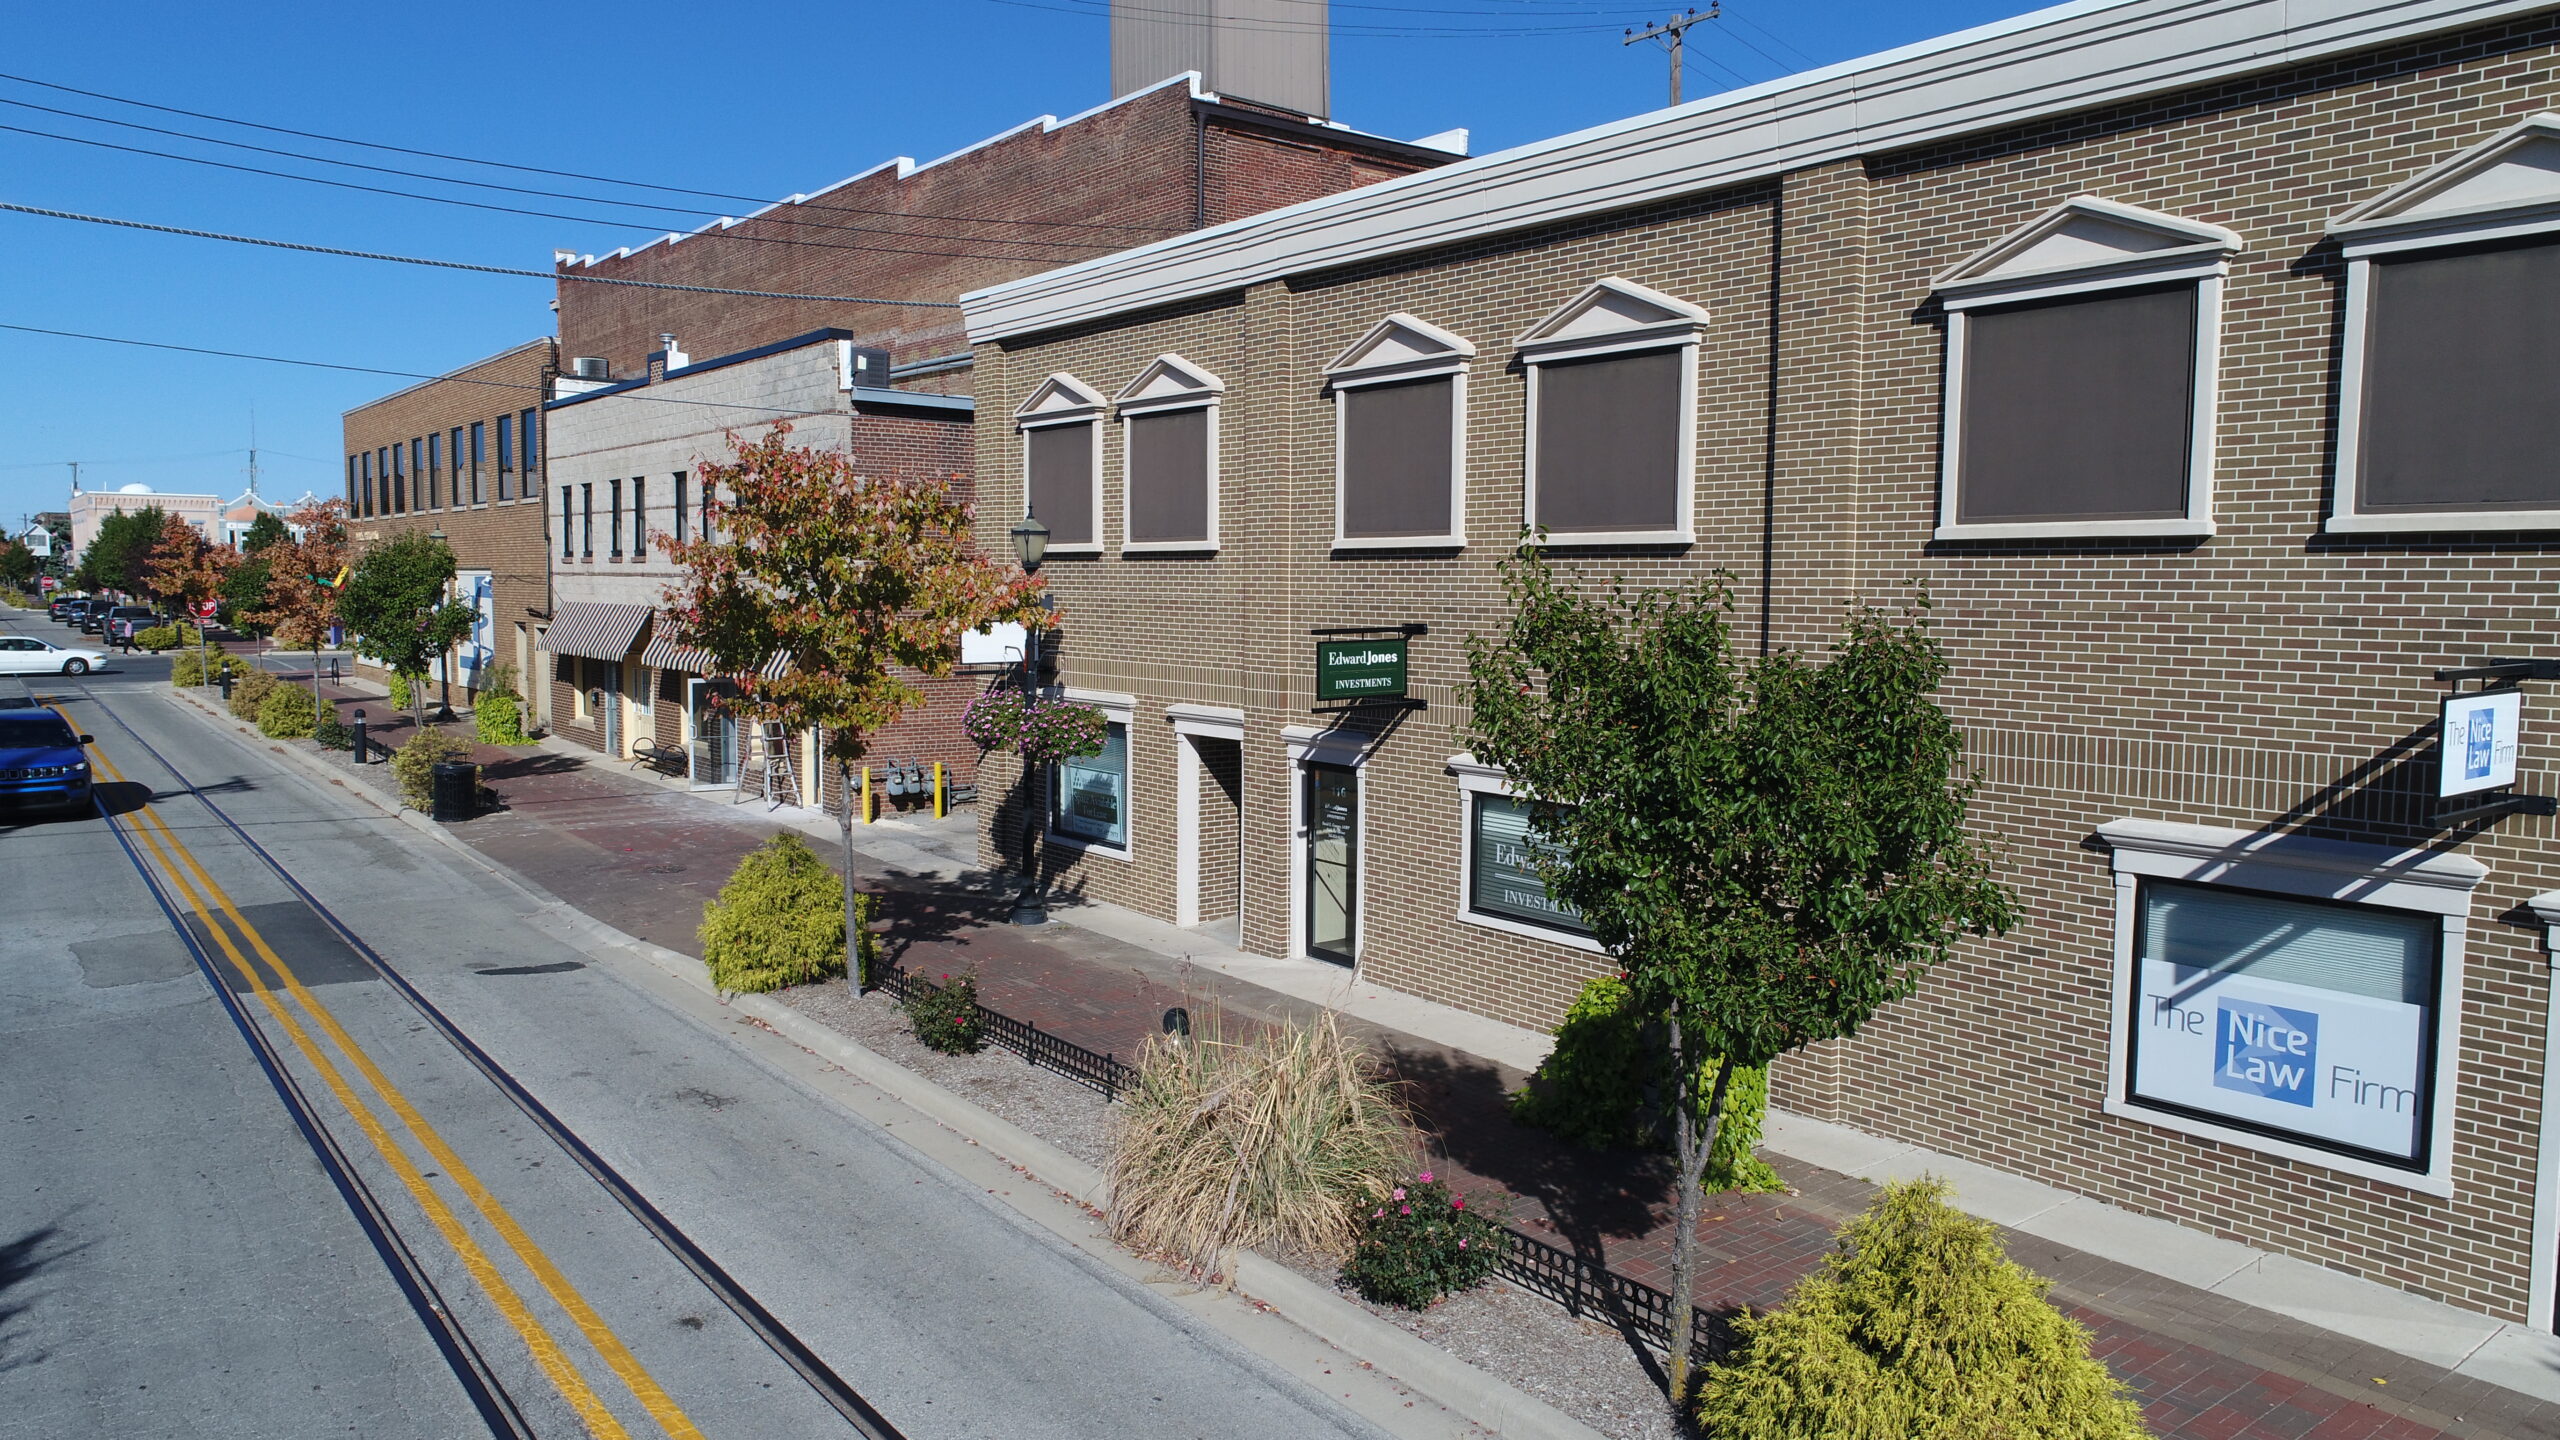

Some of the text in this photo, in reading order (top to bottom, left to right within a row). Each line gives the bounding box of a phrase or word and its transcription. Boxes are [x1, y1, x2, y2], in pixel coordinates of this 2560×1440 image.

[1328, 650, 1398, 666] EdwardJones
[1335, 677, 1392, 690] INVESTMENTS
[2448, 719, 2492, 746] The Nice
[2468, 740, 2515, 770] Law Firm
[2147, 993, 2309, 1057] The Nice
[2225, 1043, 2417, 1117] Law Firm
